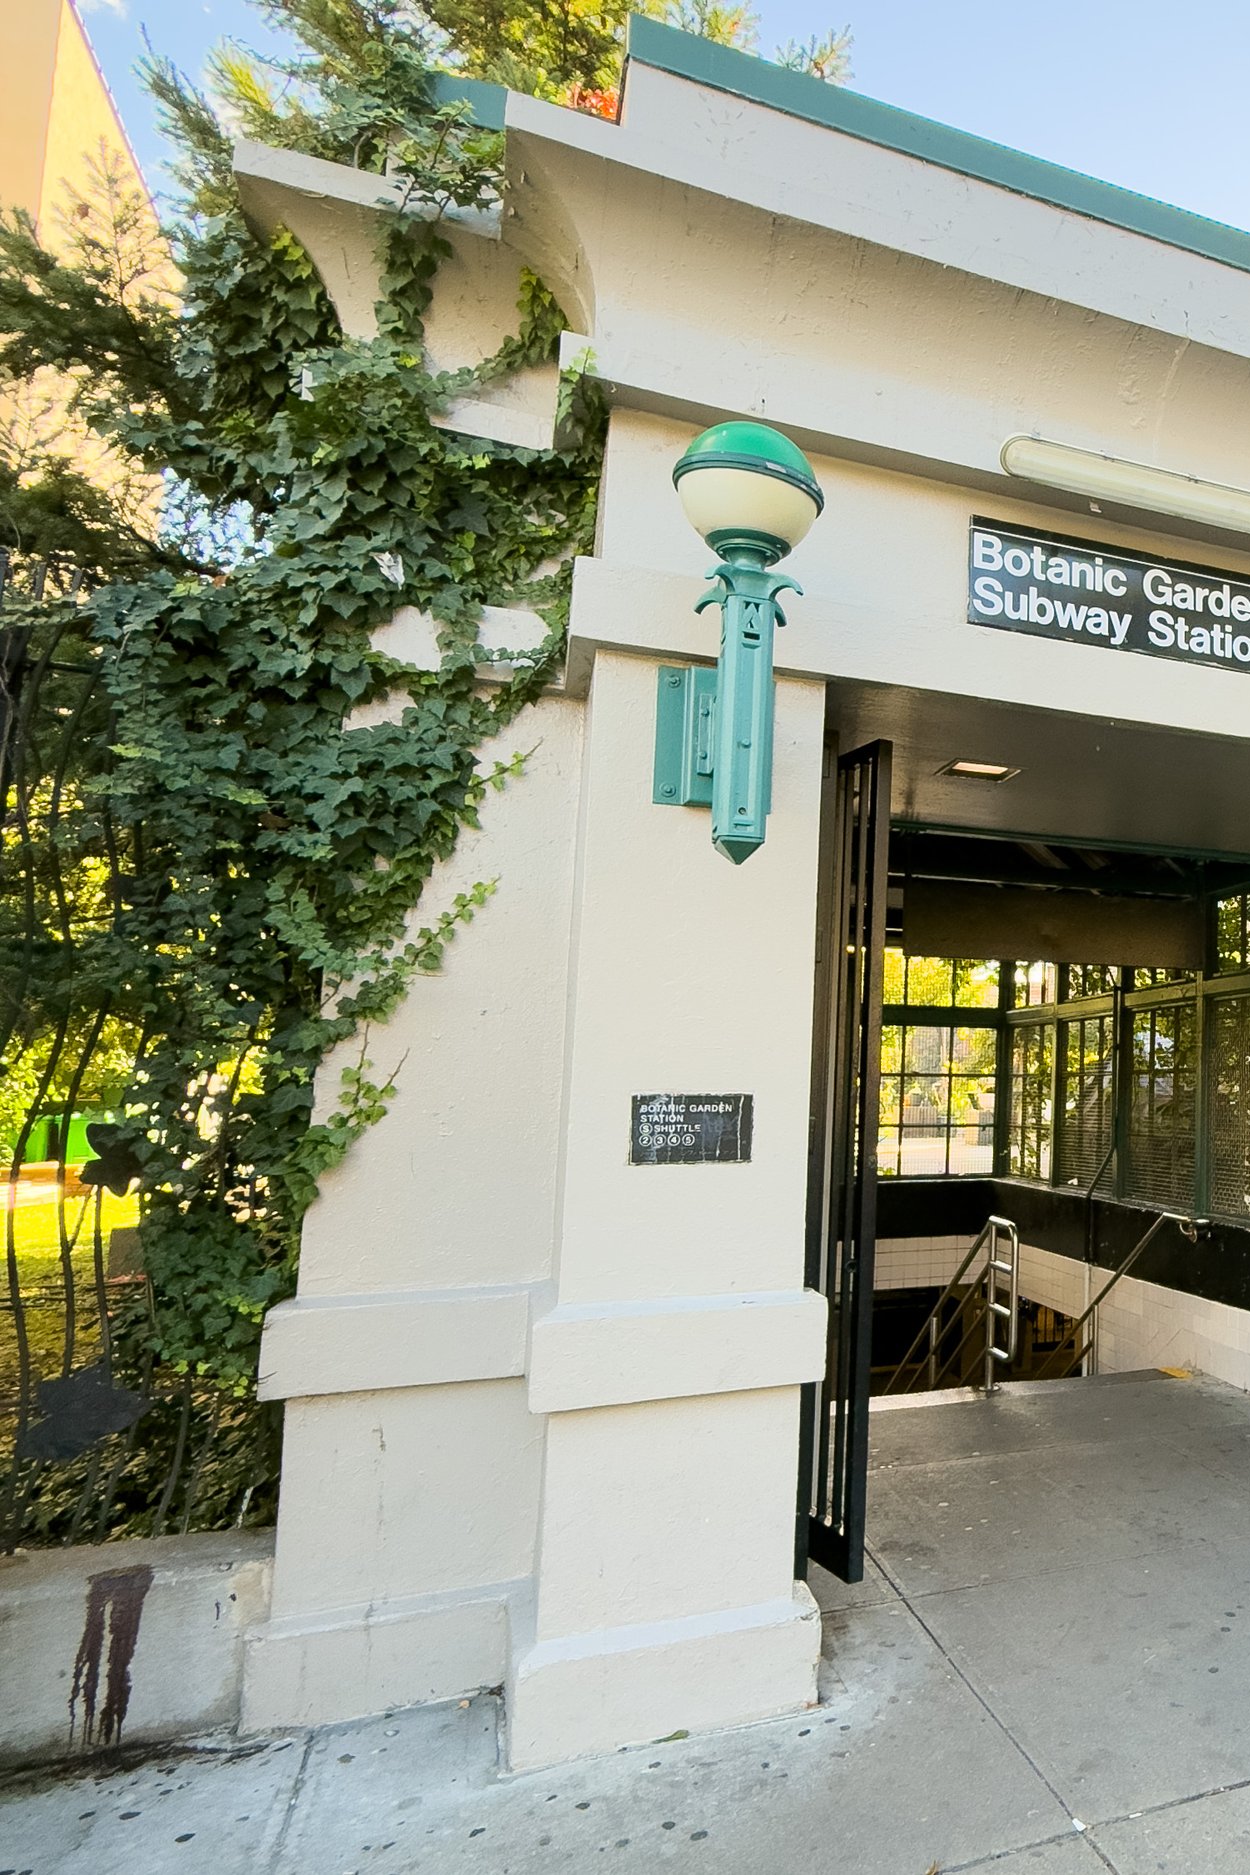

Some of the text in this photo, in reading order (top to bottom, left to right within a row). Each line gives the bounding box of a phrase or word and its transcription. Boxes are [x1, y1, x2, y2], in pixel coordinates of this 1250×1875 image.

[973, 532, 1127, 597] Botanic
[973, 577, 1132, 645] Subway
[640, 1103, 733, 1113] BOTANIC GARDEN
[640, 1114, 684, 1123] STATION
[654, 1124, 701, 1133] SHUTTLE
